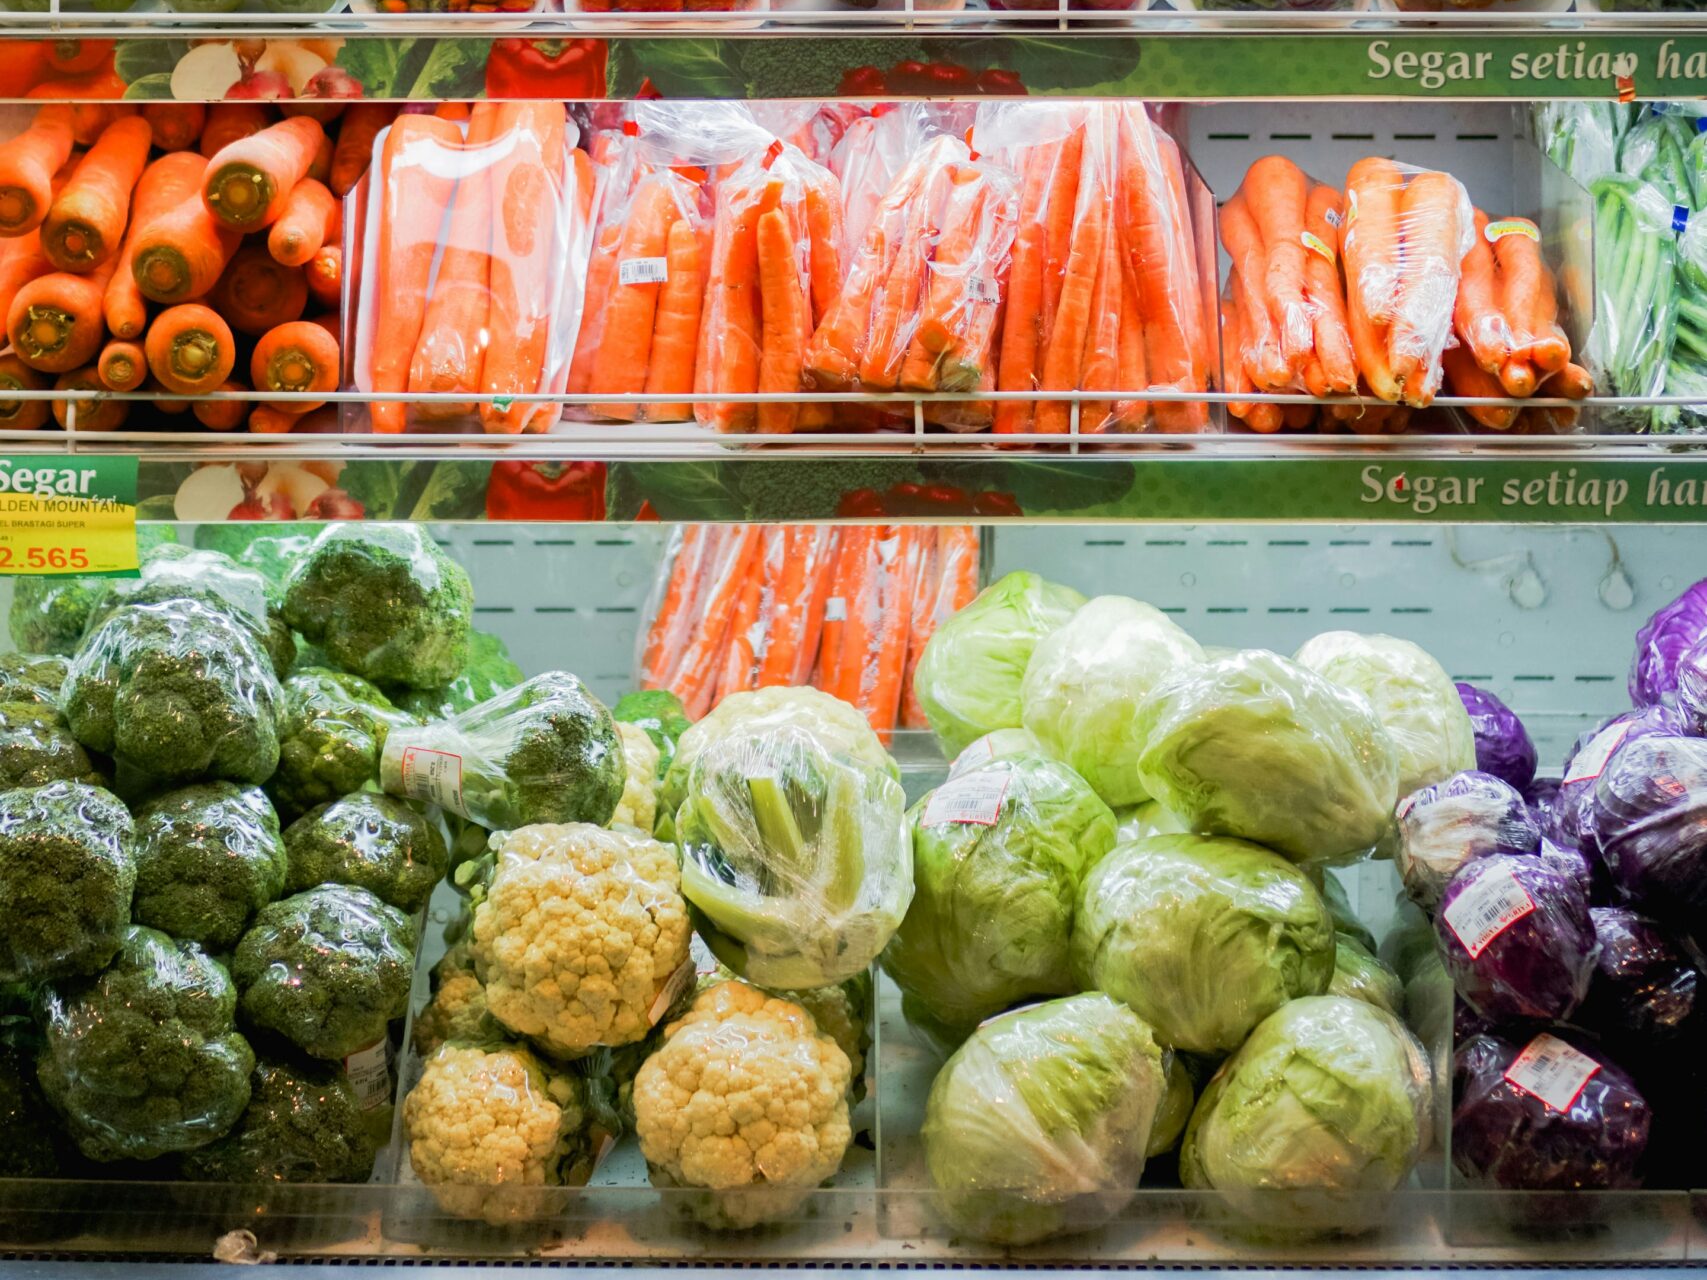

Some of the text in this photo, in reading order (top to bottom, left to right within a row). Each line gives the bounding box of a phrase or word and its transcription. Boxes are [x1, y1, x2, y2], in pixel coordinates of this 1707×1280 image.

[1367, 40, 1493, 90] Segar
[44, 500, 126, 513] MOUNTAIN
[1360, 465, 1485, 515] Segar
[1502, 467, 1630, 517] setiap
[57, 520, 85, 529] SUPER
